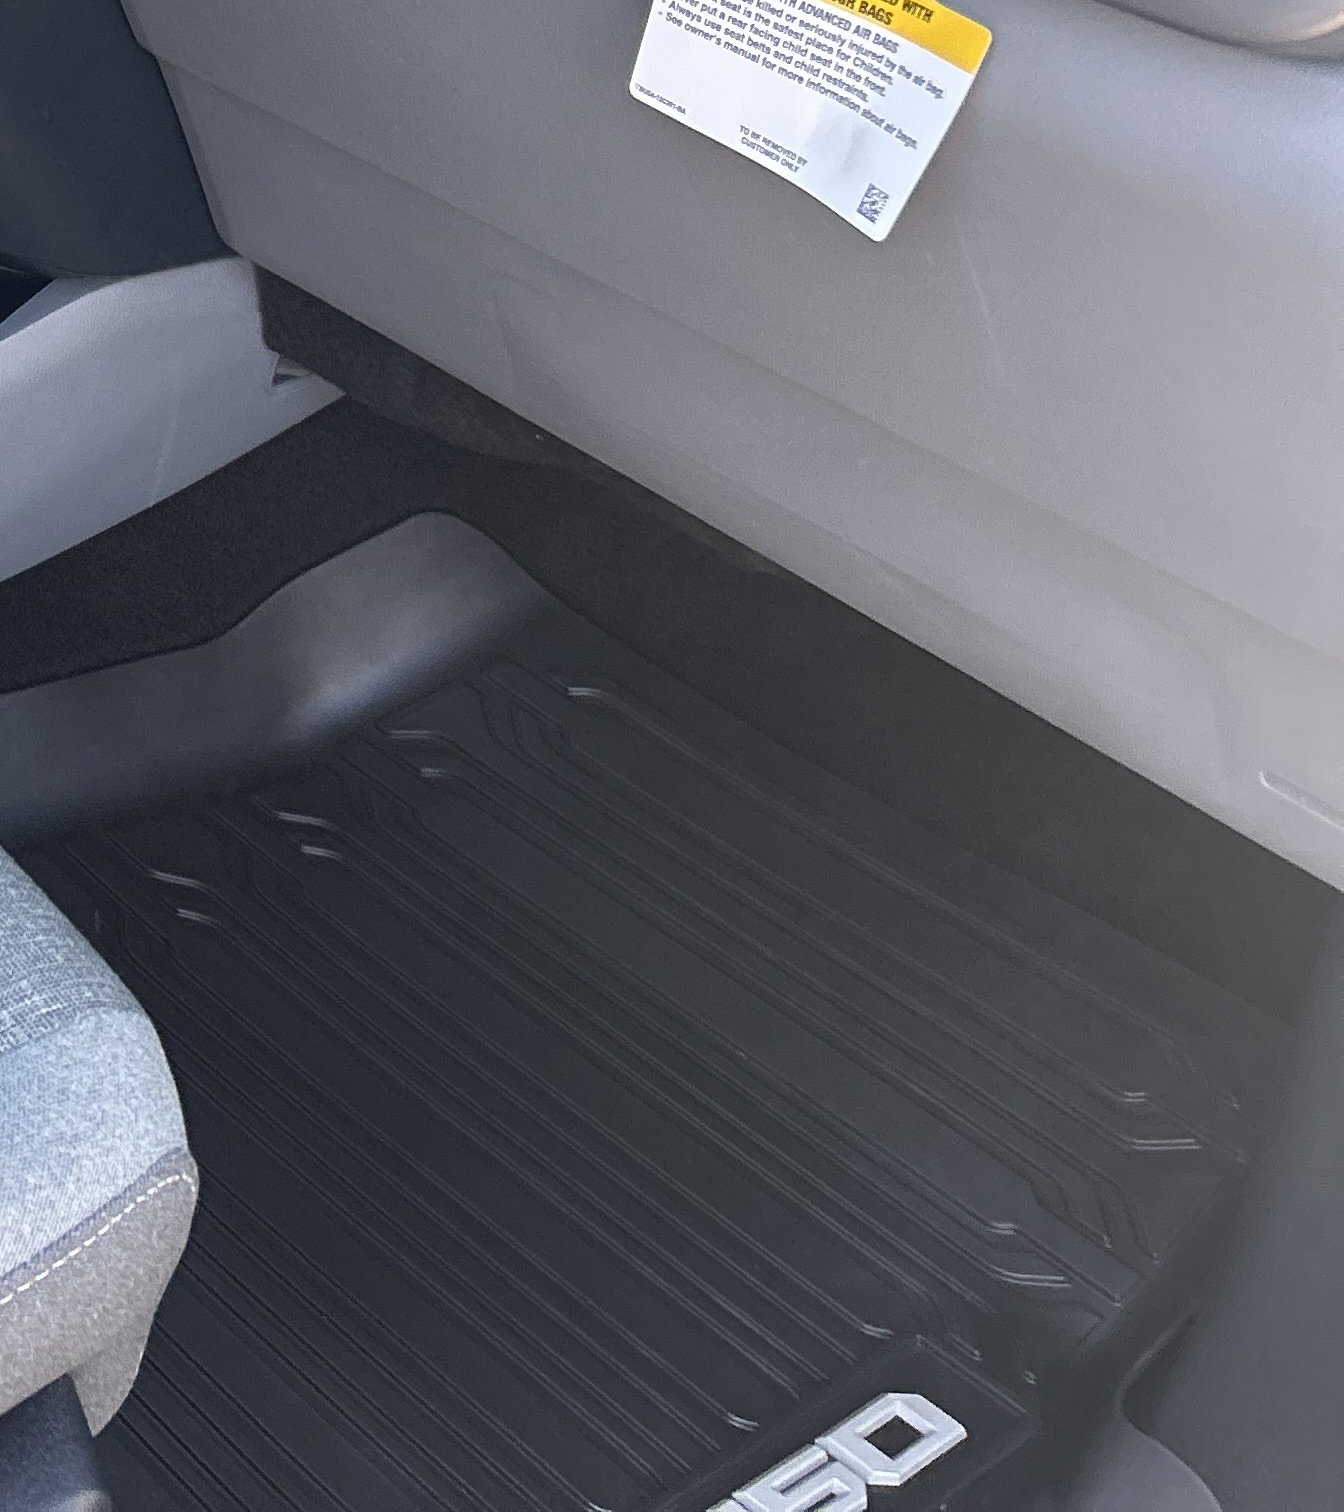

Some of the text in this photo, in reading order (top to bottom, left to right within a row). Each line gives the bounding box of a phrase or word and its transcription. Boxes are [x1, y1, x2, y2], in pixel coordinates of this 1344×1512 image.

[668, 0, 702, 23] Always
[704, 18, 722, 32] use
[724, 27, 746, 43] seat
[746, 36, 772, 55] belts
[773, 48, 793, 64] and
[794, 59, 821, 77] child
[700, 3, 718, 18] put
[727, 15, 748, 30] rear
[749, 23, 781, 47] facing
[782, 39, 808, 57] child
[809, 52, 832, 69] seat
[834, 62, 845, 74] in
[846, 67, 862, 83] the
[743, 7, 752, 19] is
[754, 12, 771, 26] the
[772, 21, 804, 41] safest
[805, 36, 834, 54] place
[836, 48, 851, 63] for
[798, 1, 852, 31] ADVANCED
[852, 25, 872, 40] AIR
[872, 33, 899, 54] BAGS
[858, 1, 894, 25] BAGS
[665, 11, 683, 27] See
[684, 22, 722, 46] owner's
[723, 41, 761, 64] manual
[761, 57, 777, 71] for
[777, 66, 804, 85] more
[806, 78, 861, 113] information
[785, 12, 797, 24] or
[798, 18, 846, 47] seriously
[847, 39, 885, 63] injured
[884, 57, 897, 72] by
[897, 65, 912, 79] the
[739, 124, 750, 135] TO
[741, 137, 780, 162] CUSTOMER
[706, 1392, 967, 1512] 50
